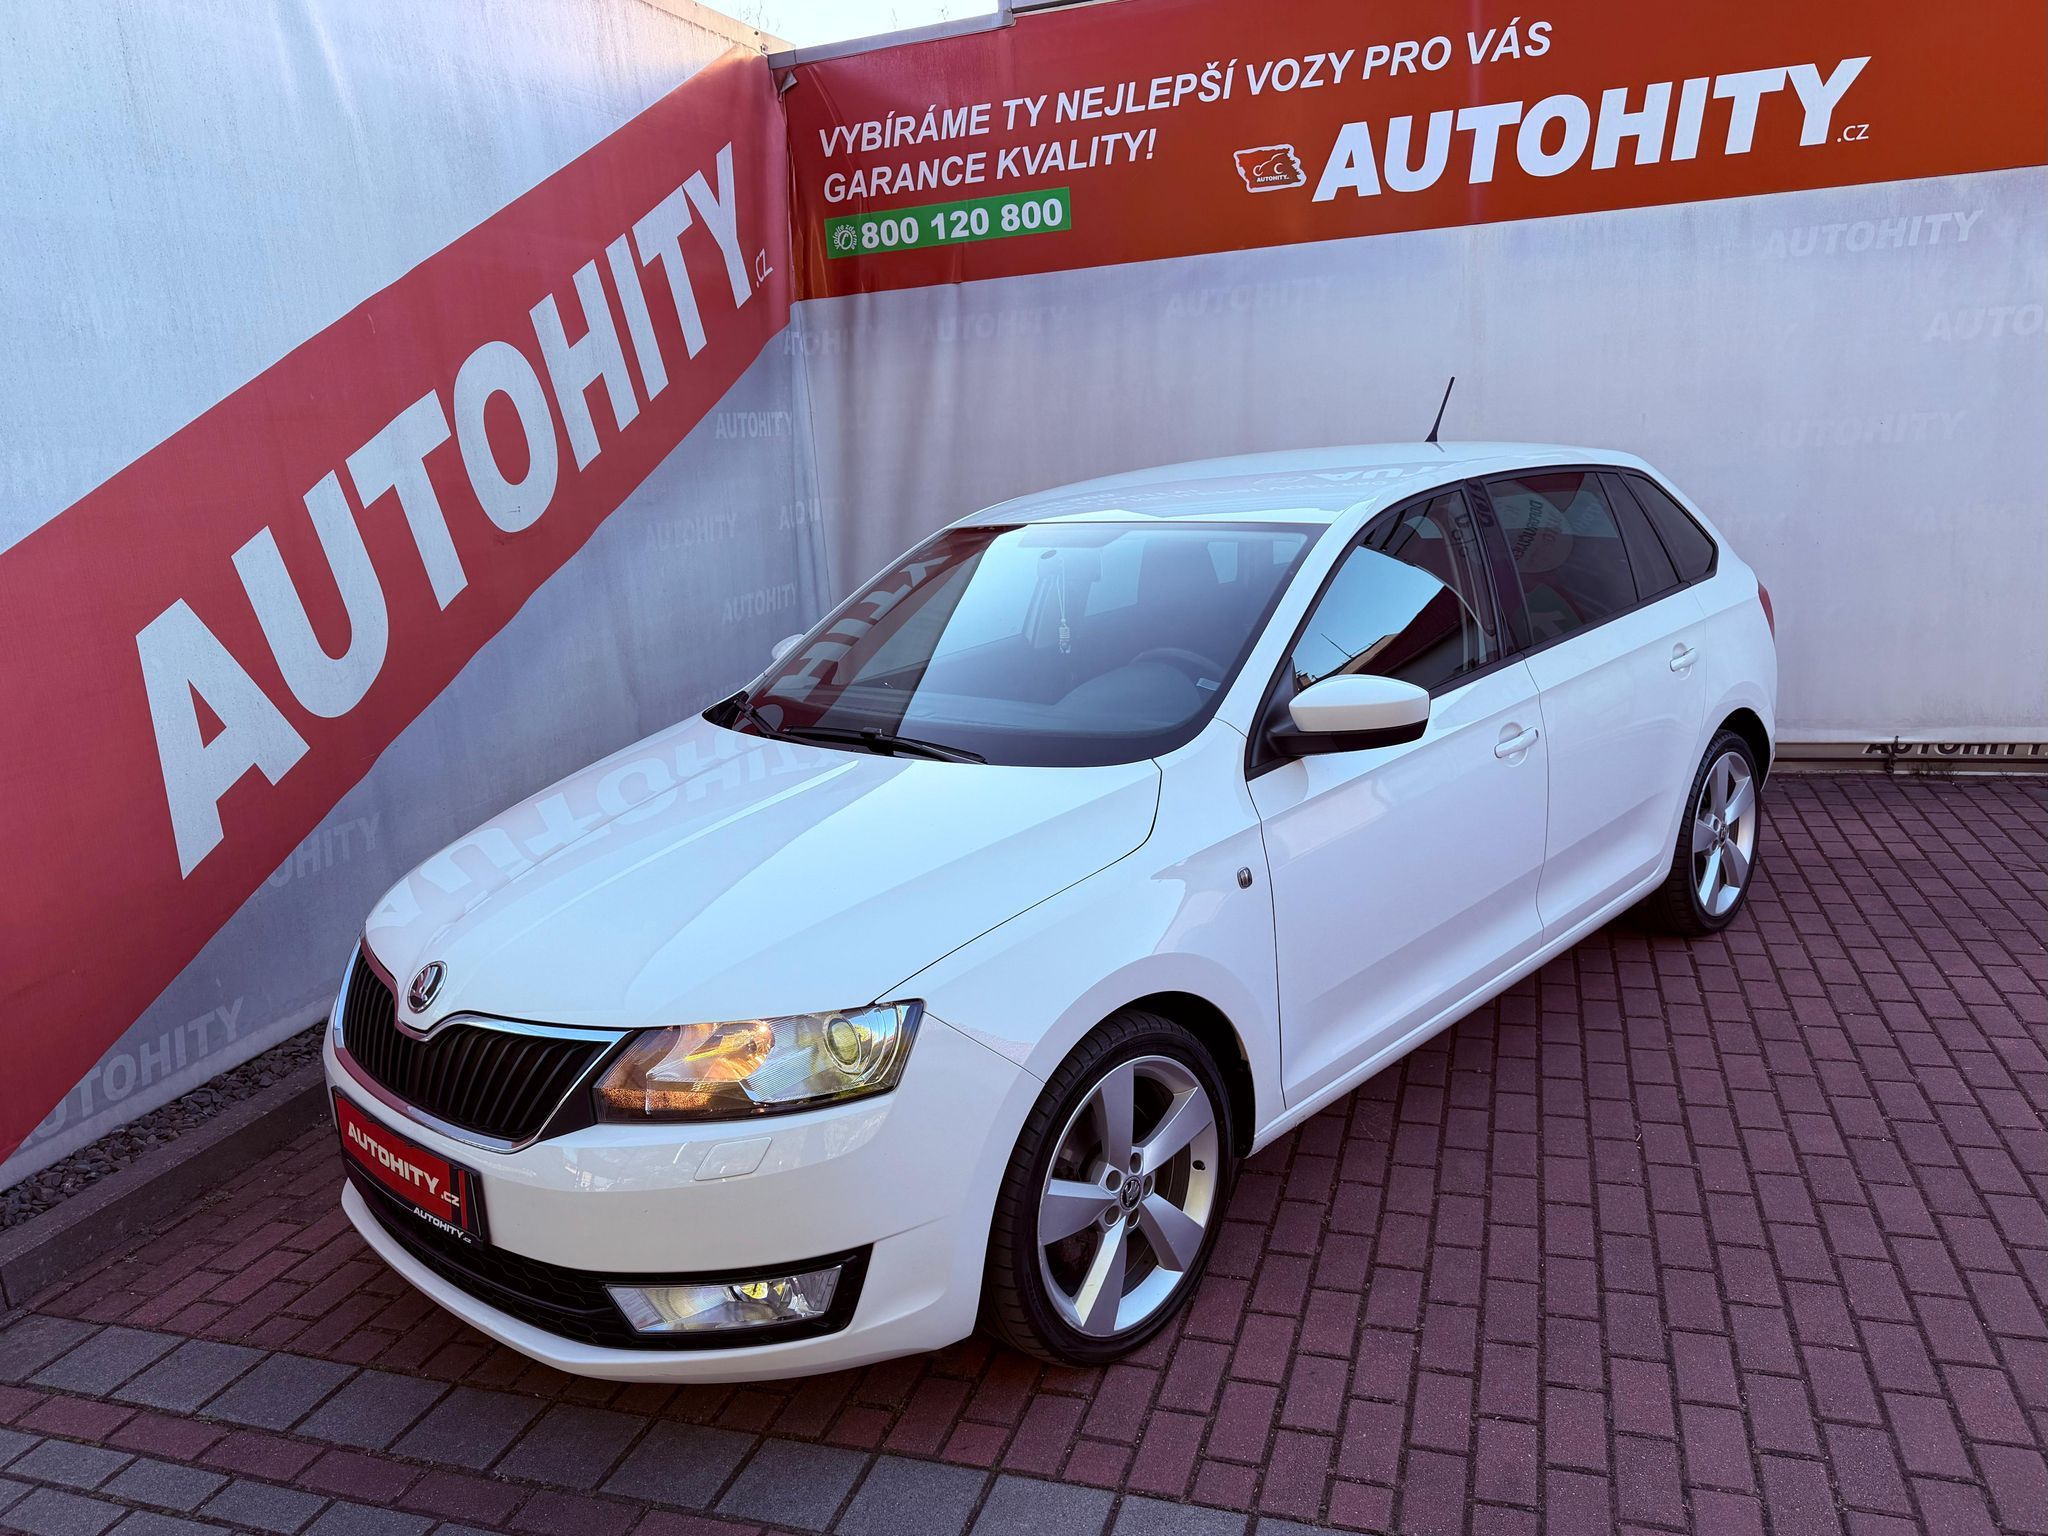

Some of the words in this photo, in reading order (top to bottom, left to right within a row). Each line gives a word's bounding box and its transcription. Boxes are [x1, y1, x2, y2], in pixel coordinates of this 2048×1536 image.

[819, 103, 991, 158] VYBÍRÁME
[1002, 95, 1048, 130] TY
[1055, 58, 1238, 123] NEJLEPŠÍ
[1246, 49, 1355, 96] VOZY
[1362, 36, 1452, 80] PRO
[1467, 17, 1552, 64] VÁS
[823, 152, 987, 203] GARANCE
[996, 128, 1157, 180] KVALITY!
[861, 217, 919, 249] 800
[930, 208, 990, 240] 120
[1000, 198, 1063, 230] 800
[1760, 210, 1984, 262] AUTOHITY
[714, 411, 793, 440] AUTOHITY
[20, 997, 244, 1150] UTOHITY
